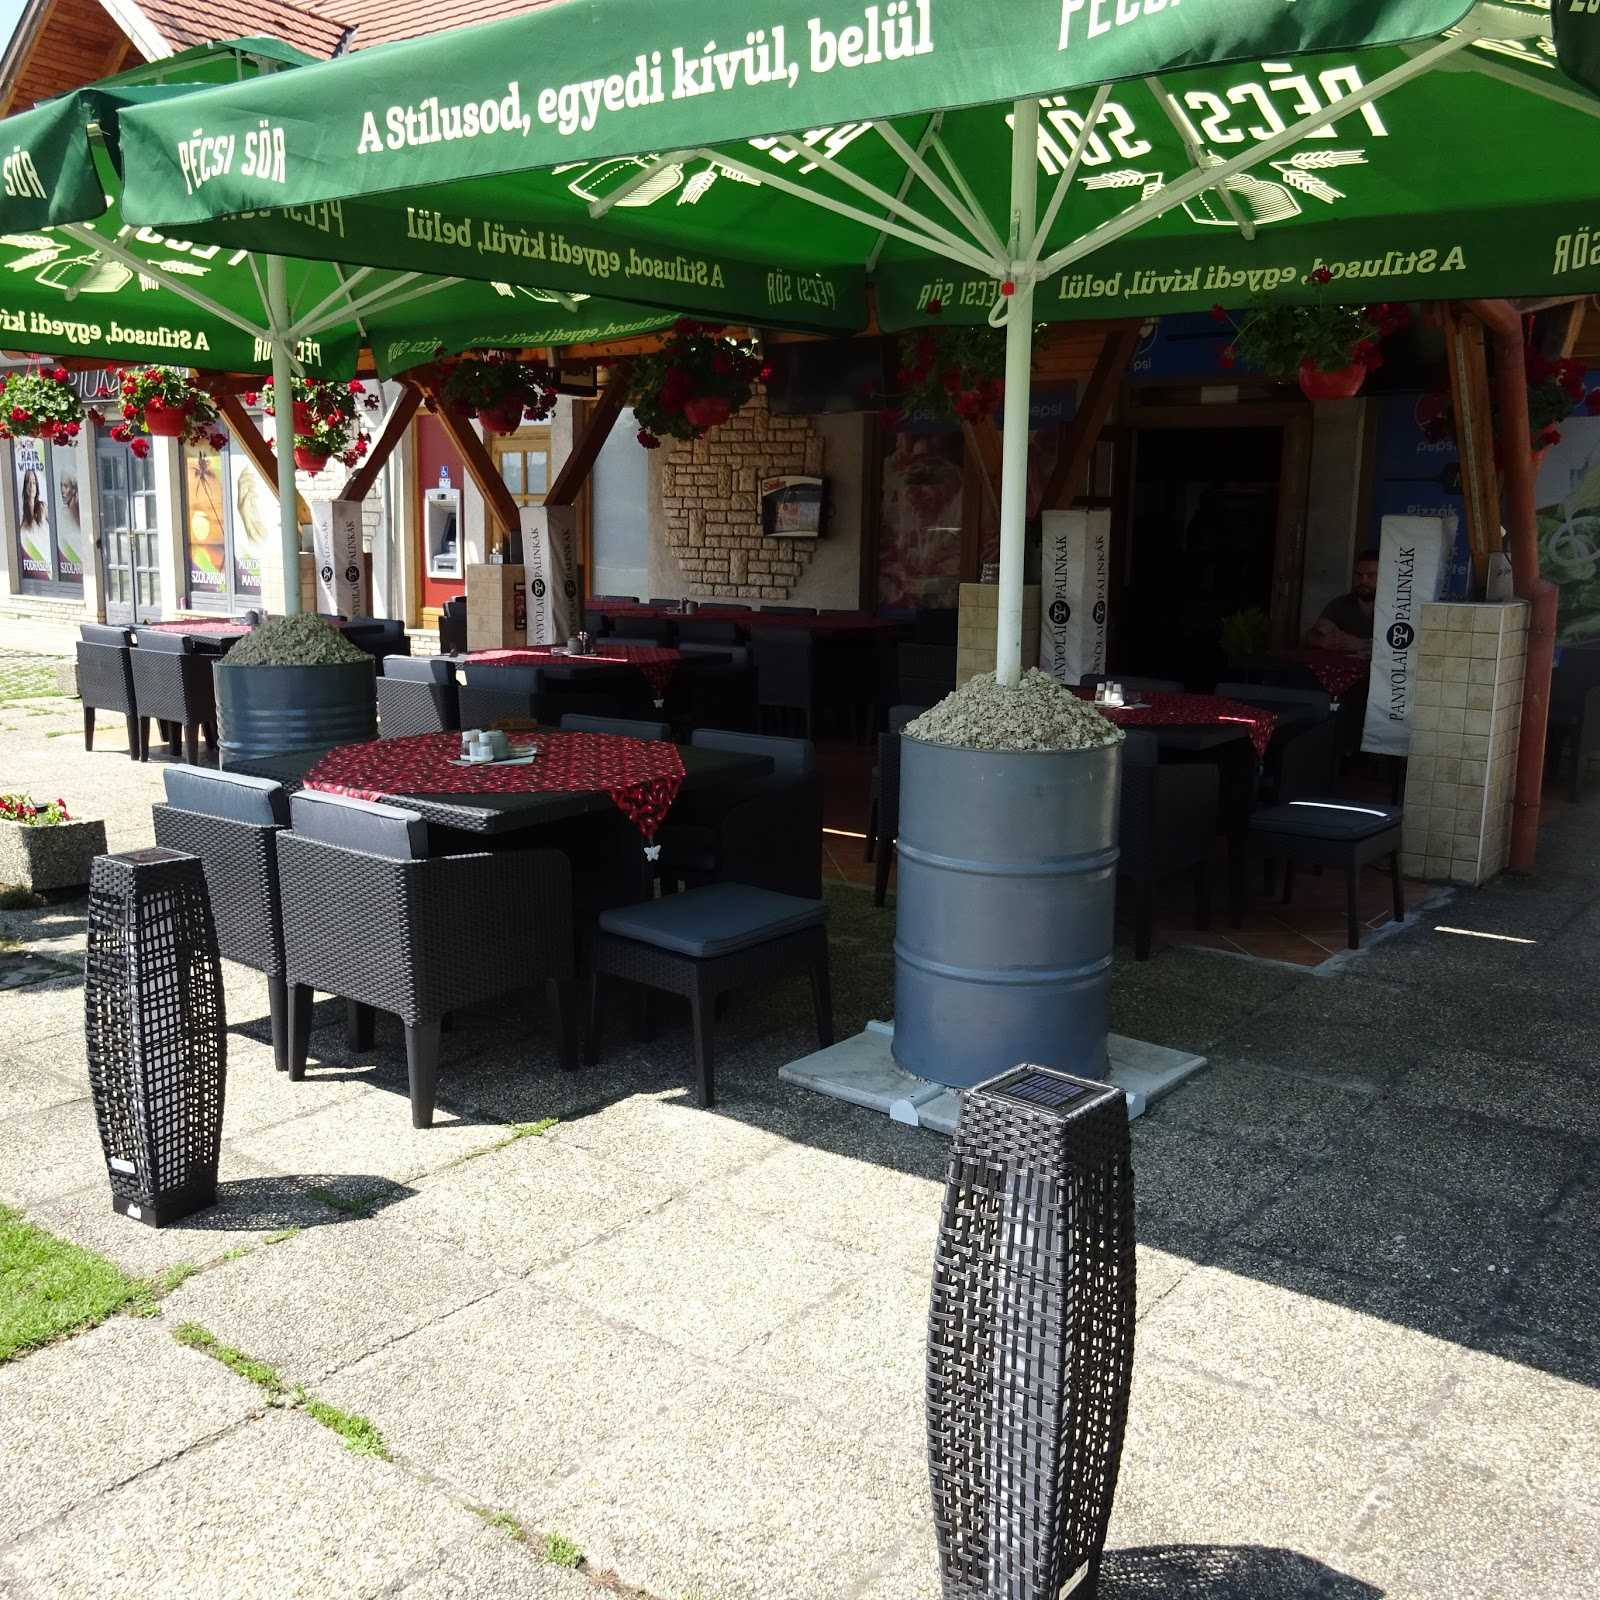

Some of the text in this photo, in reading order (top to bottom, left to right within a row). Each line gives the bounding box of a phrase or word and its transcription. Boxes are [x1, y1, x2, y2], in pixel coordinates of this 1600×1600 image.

[357, 0, 934, 154] A Stílusod, egyedi kívül, belül
[2, 145, 48, 200] SÖR
[177, 119, 287, 196] PÉCSI SÖR
[21, 450, 39, 462] HAIR
[1054, 625, 1067, 681] ANYOLAI
[1389, 546, 1415, 721] PANYOLAI PÁLINKÁK
